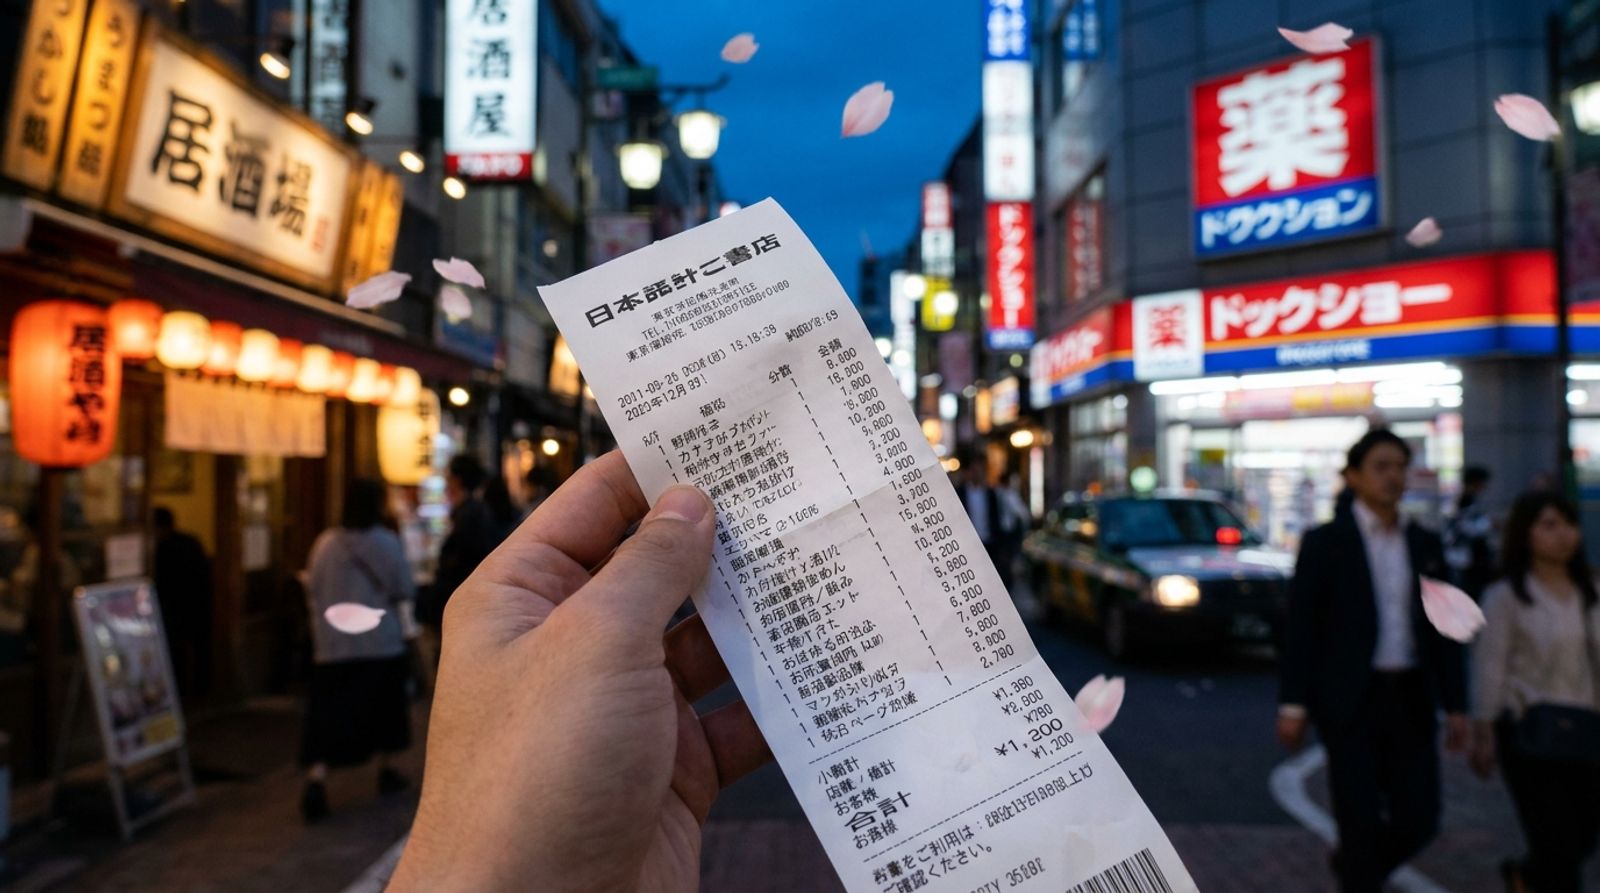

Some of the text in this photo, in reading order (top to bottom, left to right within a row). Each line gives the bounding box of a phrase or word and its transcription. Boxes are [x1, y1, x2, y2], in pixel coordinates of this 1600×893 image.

[1217, 56, 1350, 197] 薬
[1210, 280, 1453, 340] ドックショー
[1030, 732, 1073, 759] ¥1,200
[844, 791, 910, 832] 合計
